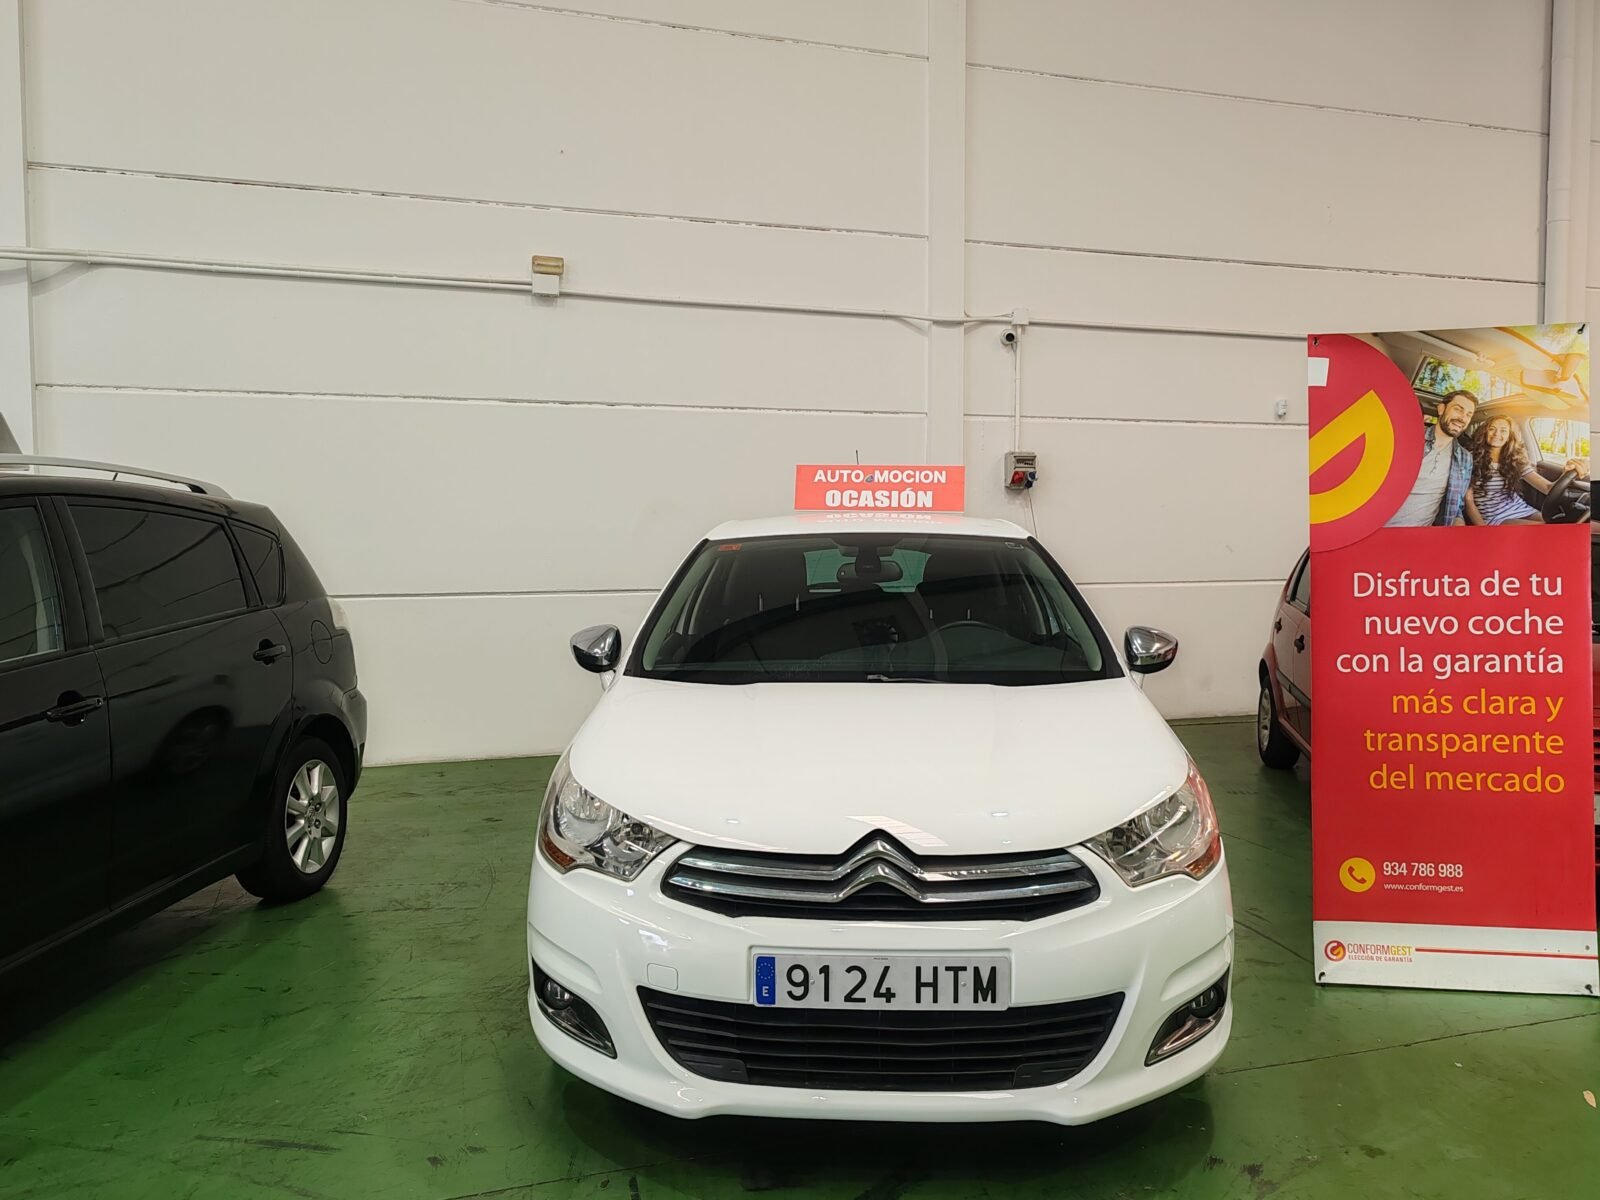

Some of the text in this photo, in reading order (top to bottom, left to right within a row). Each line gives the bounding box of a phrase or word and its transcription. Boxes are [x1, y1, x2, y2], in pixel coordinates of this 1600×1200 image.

[825, 488, 933, 508] OCASIÓN
[1353, 570, 1563, 598] Disfruta de tu
[1364, 608, 1564, 635] nuevo coche
[1336, 646, 1564, 680] con la garantía
[1392, 688, 1564, 722] más clara y
[1364, 729, 1564, 758] transparente
[1369, 763, 1565, 793] del mercado
[1383, 862, 1463, 878] 934 786 988
[1383, 882, 1464, 894] www.conformgest.es
[1347, 943, 1412, 956] CONFORMGEST
[762, 986, 769, 997] E
[786, 964, 997, 1004] 9124 HTM
